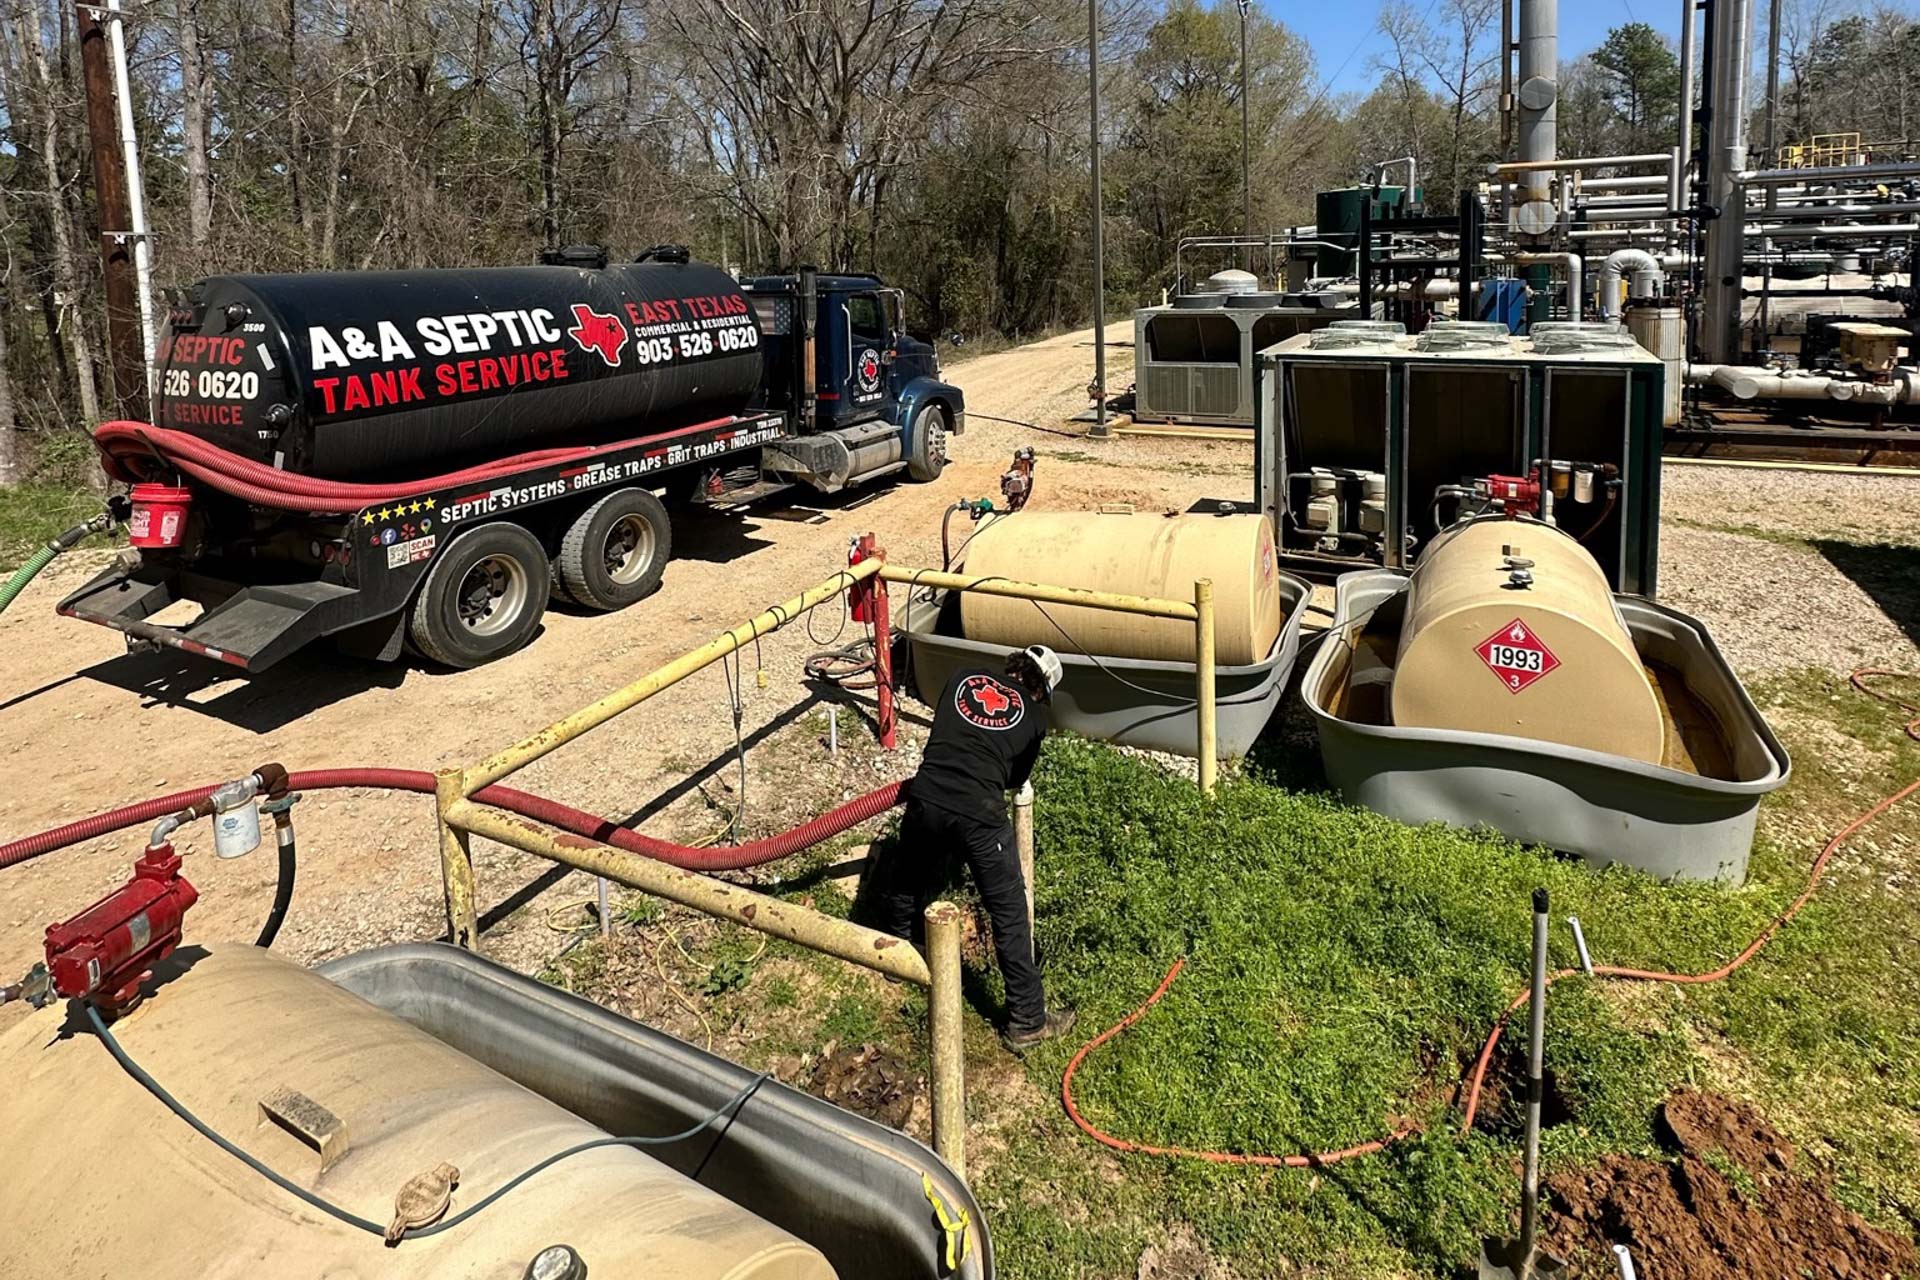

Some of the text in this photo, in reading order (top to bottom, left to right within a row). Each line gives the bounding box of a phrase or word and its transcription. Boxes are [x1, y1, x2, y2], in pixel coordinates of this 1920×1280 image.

[624, 294, 748, 324] EAST TEXAS
[243, 323, 266, 333] 3500
[308, 308, 561, 370] A&A SEPTIC
[634, 314, 752, 338] COMMERCIAL & RESIDENTIAL
[174, 336, 246, 366] SEPTIC
[199, 370, 260, 400] 0620
[314, 349, 568, 414] TANK SERVICE
[174, 404, 244, 426] SERVICE
[440, 426, 780, 524] SEPTIC SYSTEMS GREASE TRAPS GRIT TRAPS INDUSTRIAL
[411, 538, 434, 551] SCAN
[1493, 646, 1540, 670] 1993
[1510, 675, 1520, 687] 3
[959, 699, 1008, 726] TANK SERVICE
